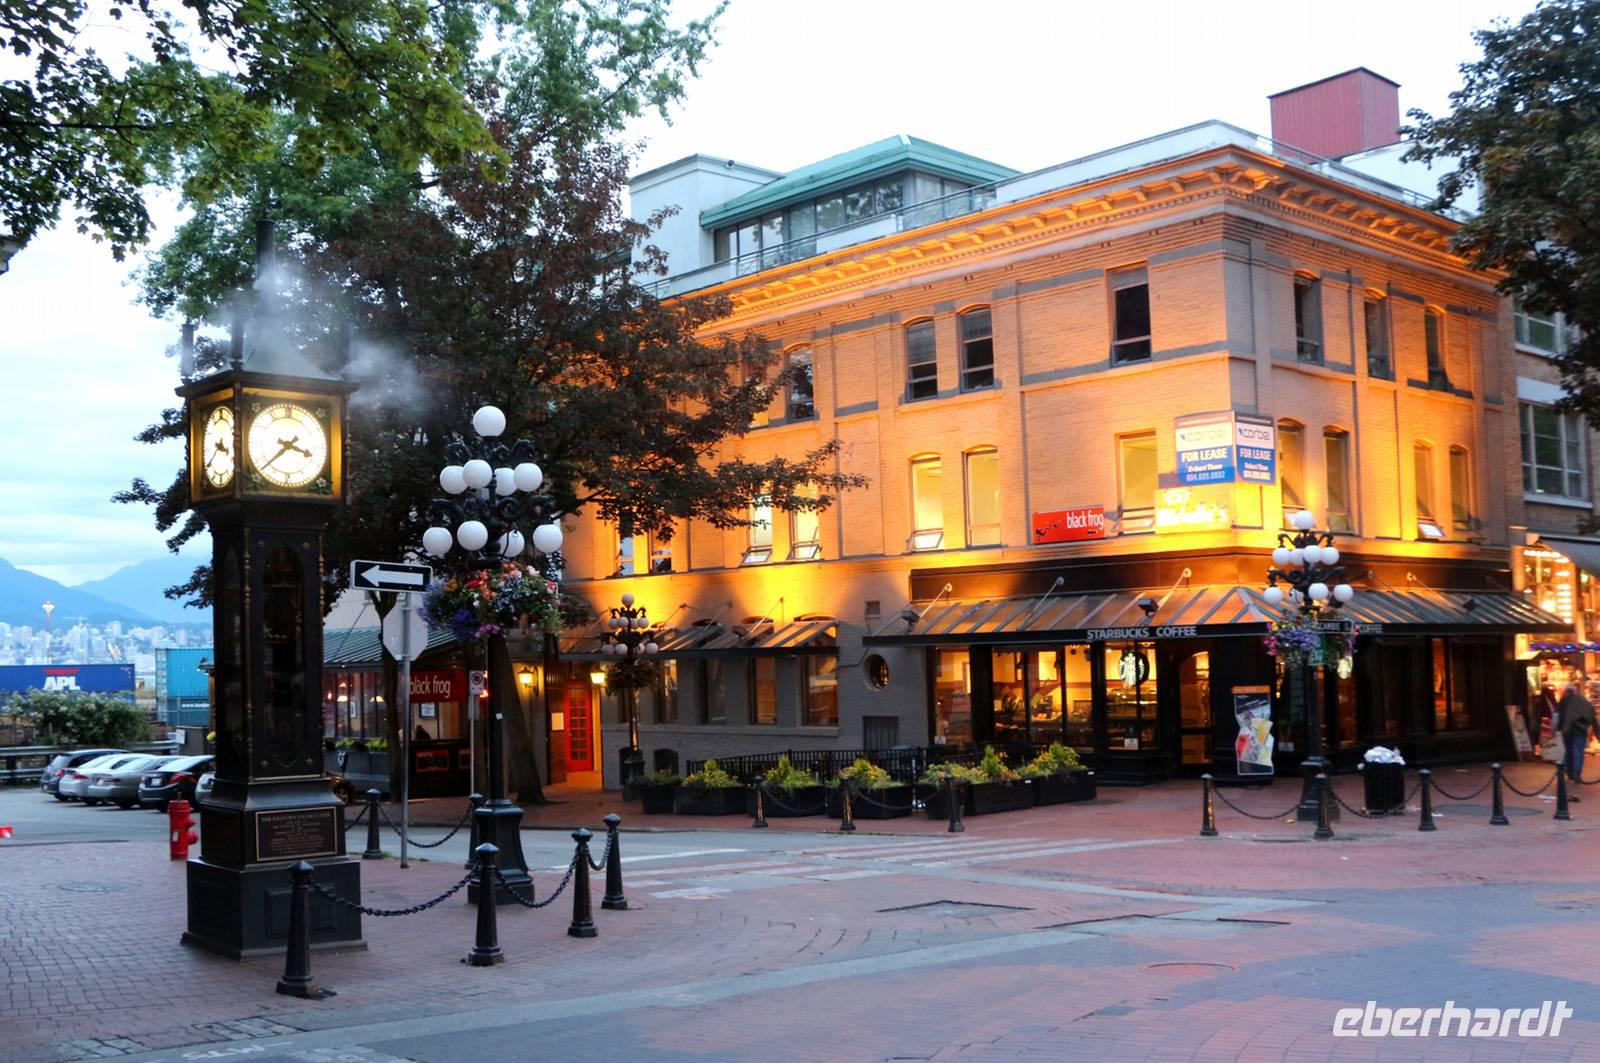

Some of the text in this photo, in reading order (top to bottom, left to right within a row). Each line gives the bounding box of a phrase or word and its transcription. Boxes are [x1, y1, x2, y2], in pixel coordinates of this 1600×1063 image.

[1182, 448, 1227, 462] FOR LEASE
[1240, 447, 1272, 460] FOR LEASE
[1066, 510, 1104, 531] black frog
[1087, 626, 1197, 640] STARBUCKS COFFEE
[42, 676, 81, 691] APL
[432, 675, 451, 698] frog
